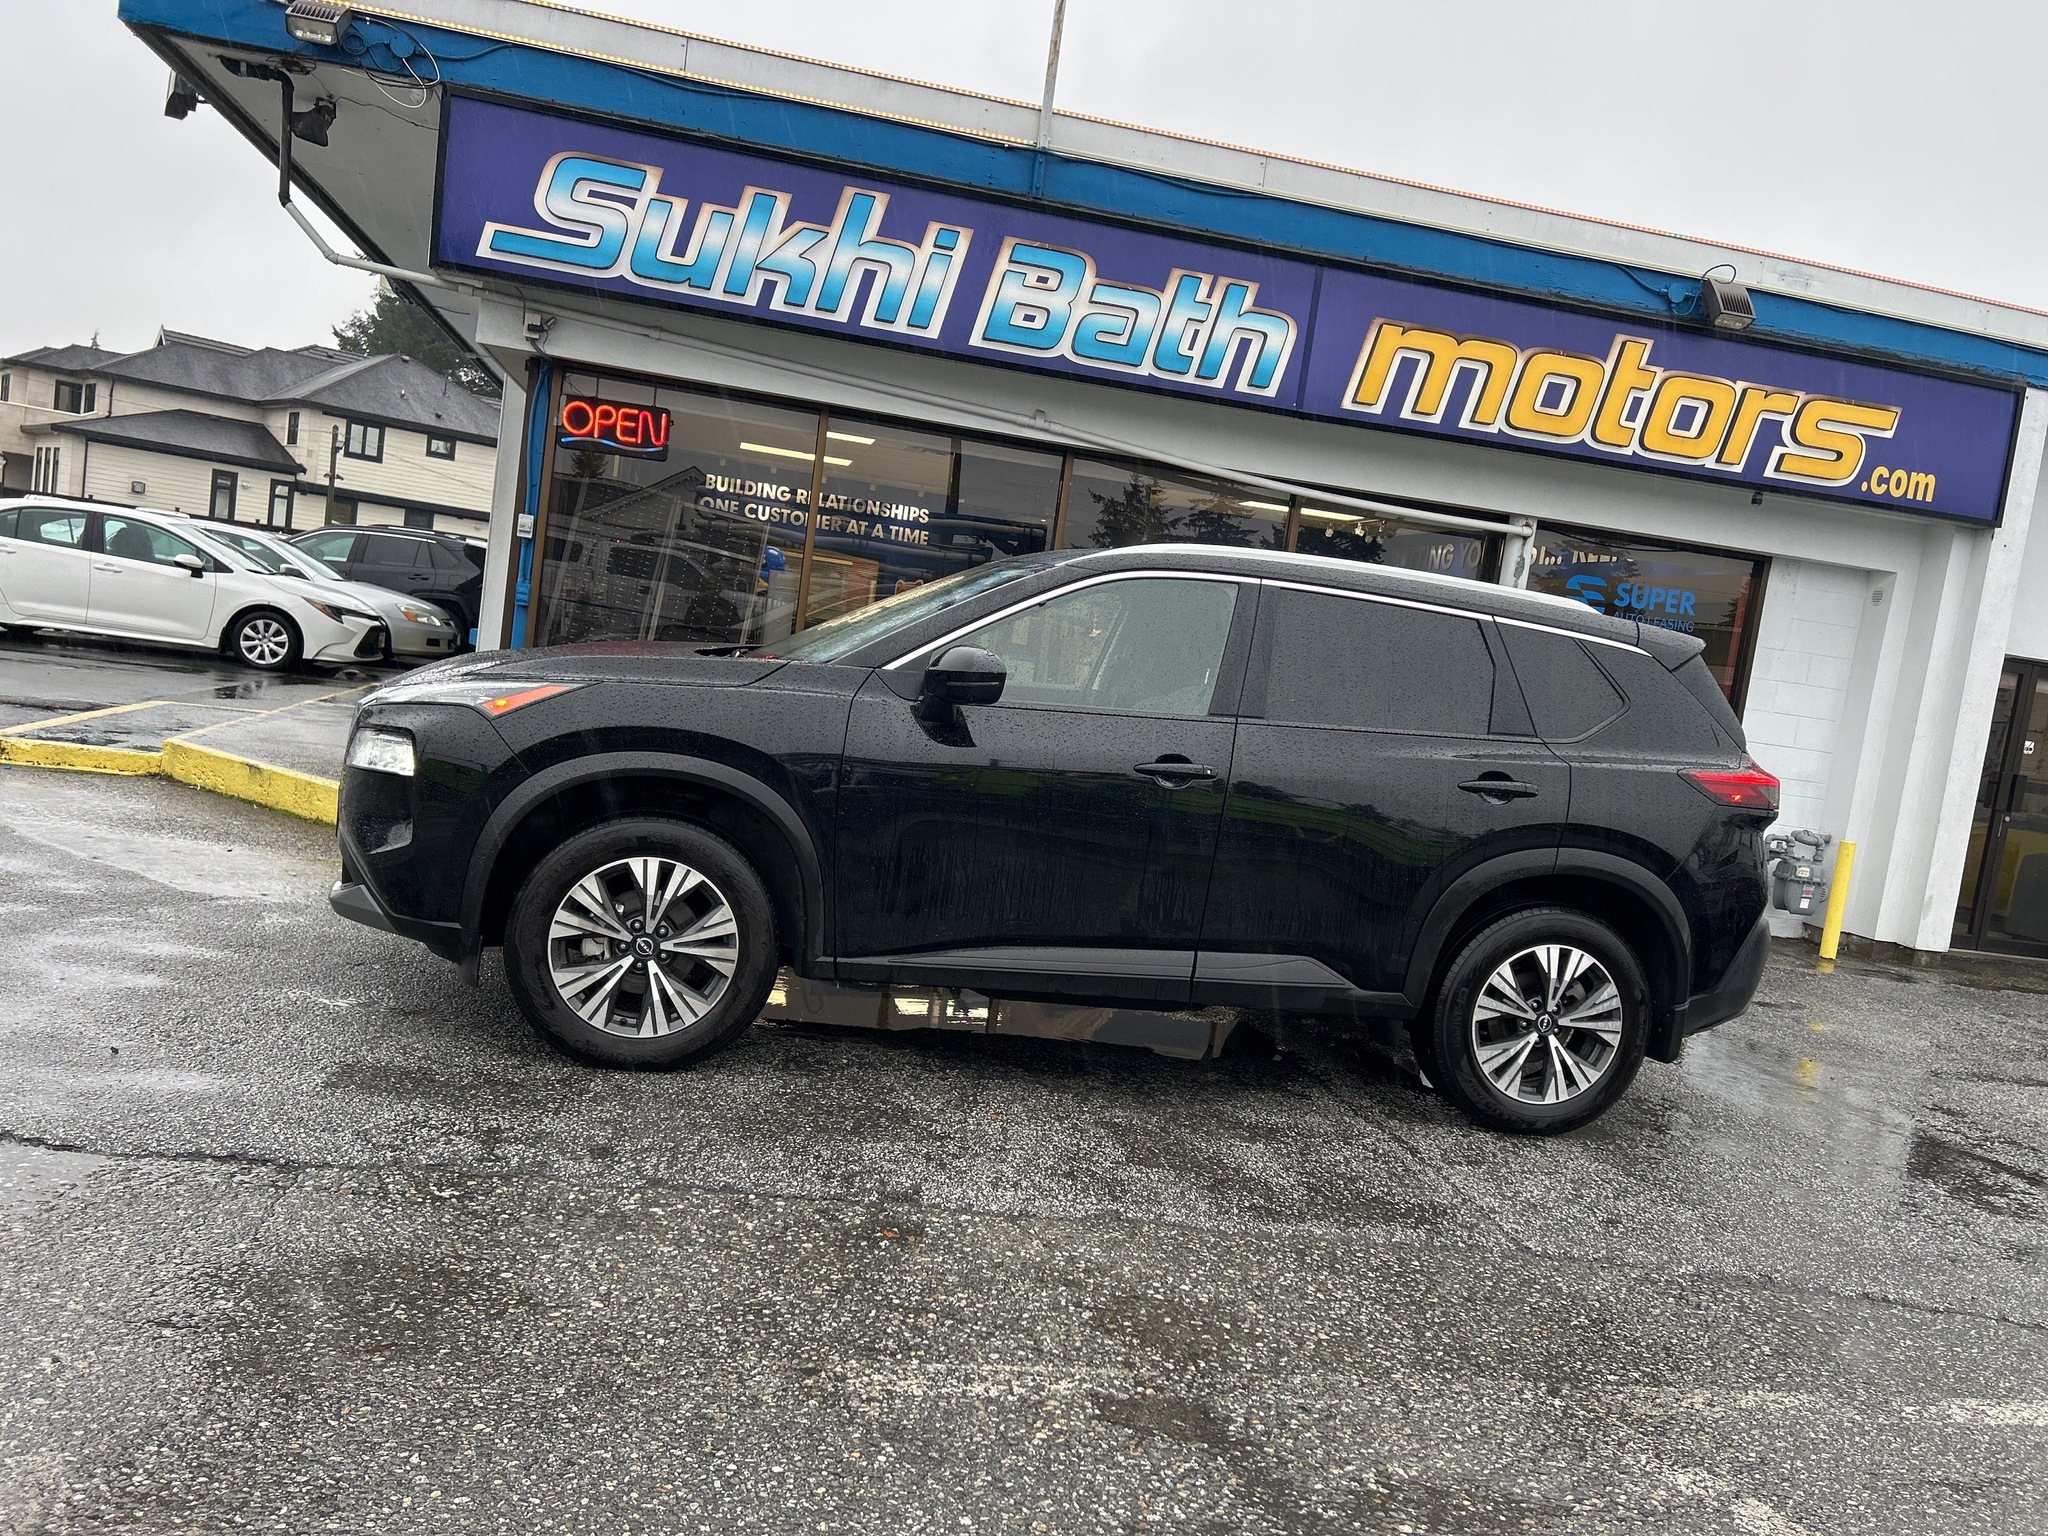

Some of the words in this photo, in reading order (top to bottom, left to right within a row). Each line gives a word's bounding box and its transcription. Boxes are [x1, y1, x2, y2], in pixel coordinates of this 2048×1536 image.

[476, 151, 974, 339] Sukhi
[968, 236, 1298, 397] Bath
[562, 400, 668, 446] OPEN
[705, 474, 791, 501] BUILDING
[700, 496, 739, 514] ONE
[846, 519, 868, 536] AT
[871, 523, 884, 538] A
[889, 525, 929, 545] TIME
[1613, 582, 1696, 616] SUPER
